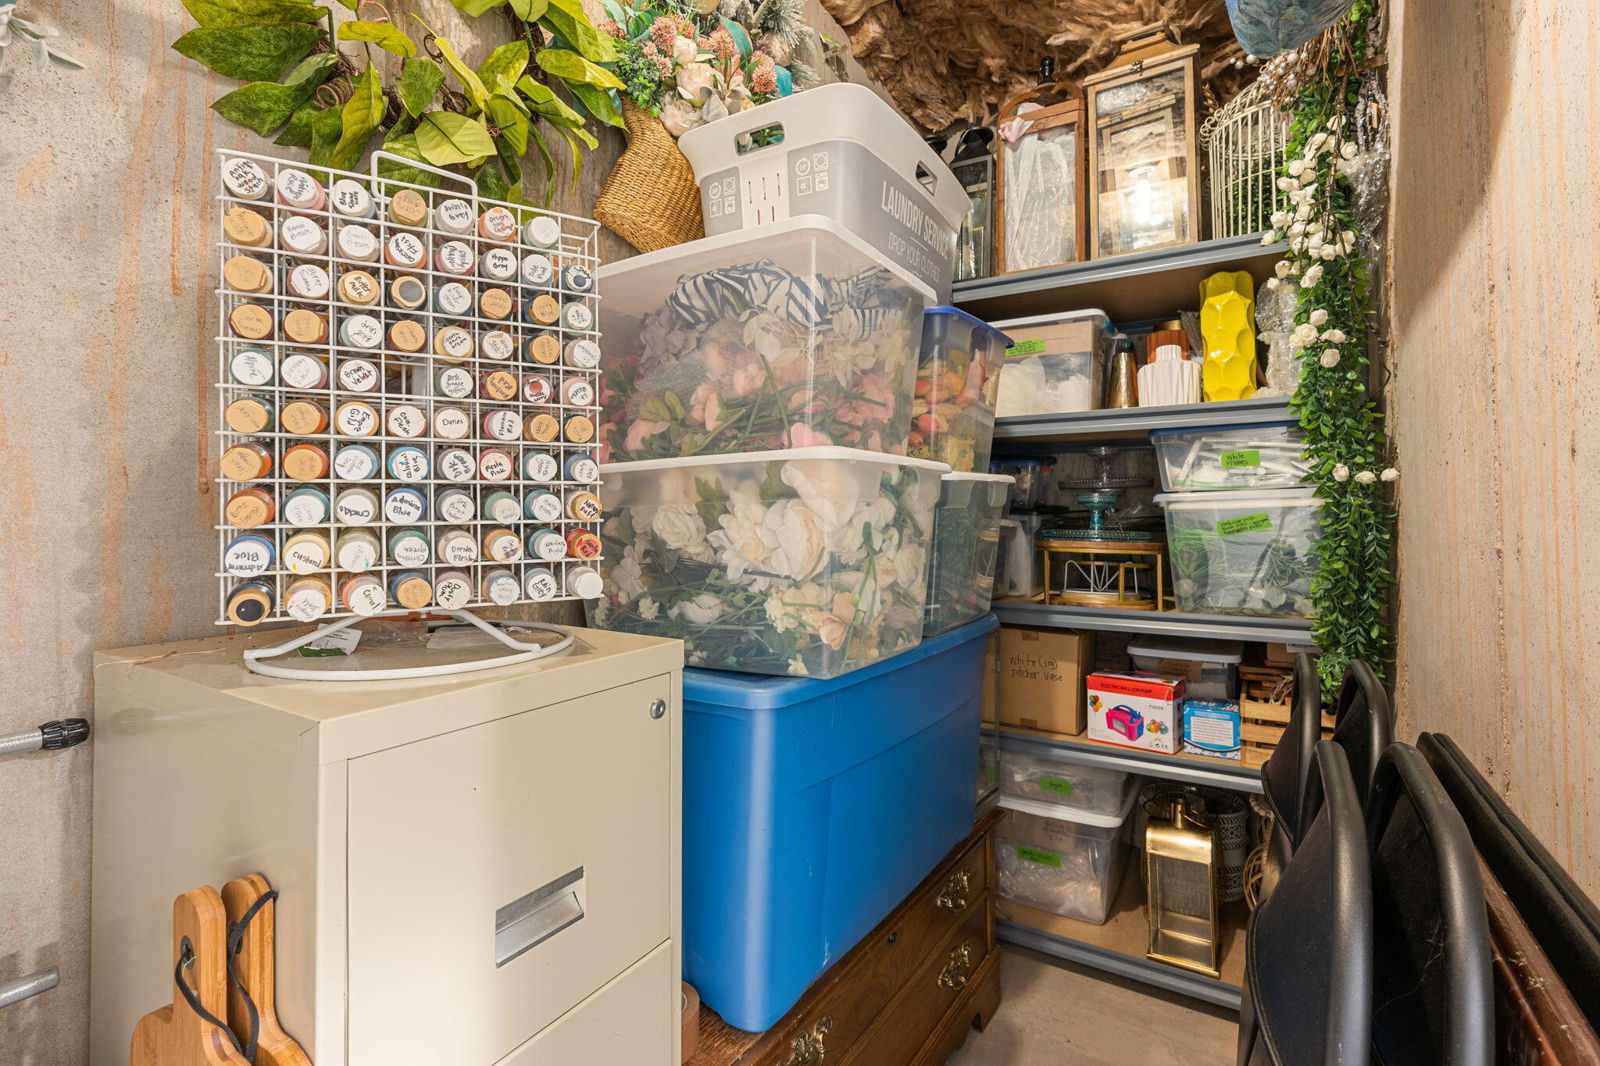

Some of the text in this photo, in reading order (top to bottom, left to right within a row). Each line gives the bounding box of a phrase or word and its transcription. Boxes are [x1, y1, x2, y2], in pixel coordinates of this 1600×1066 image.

[881, 180, 949, 261] LAUNDRY SERVICE
[888, 232, 906, 257] DROP
[906, 243, 921, 270] YOUR
